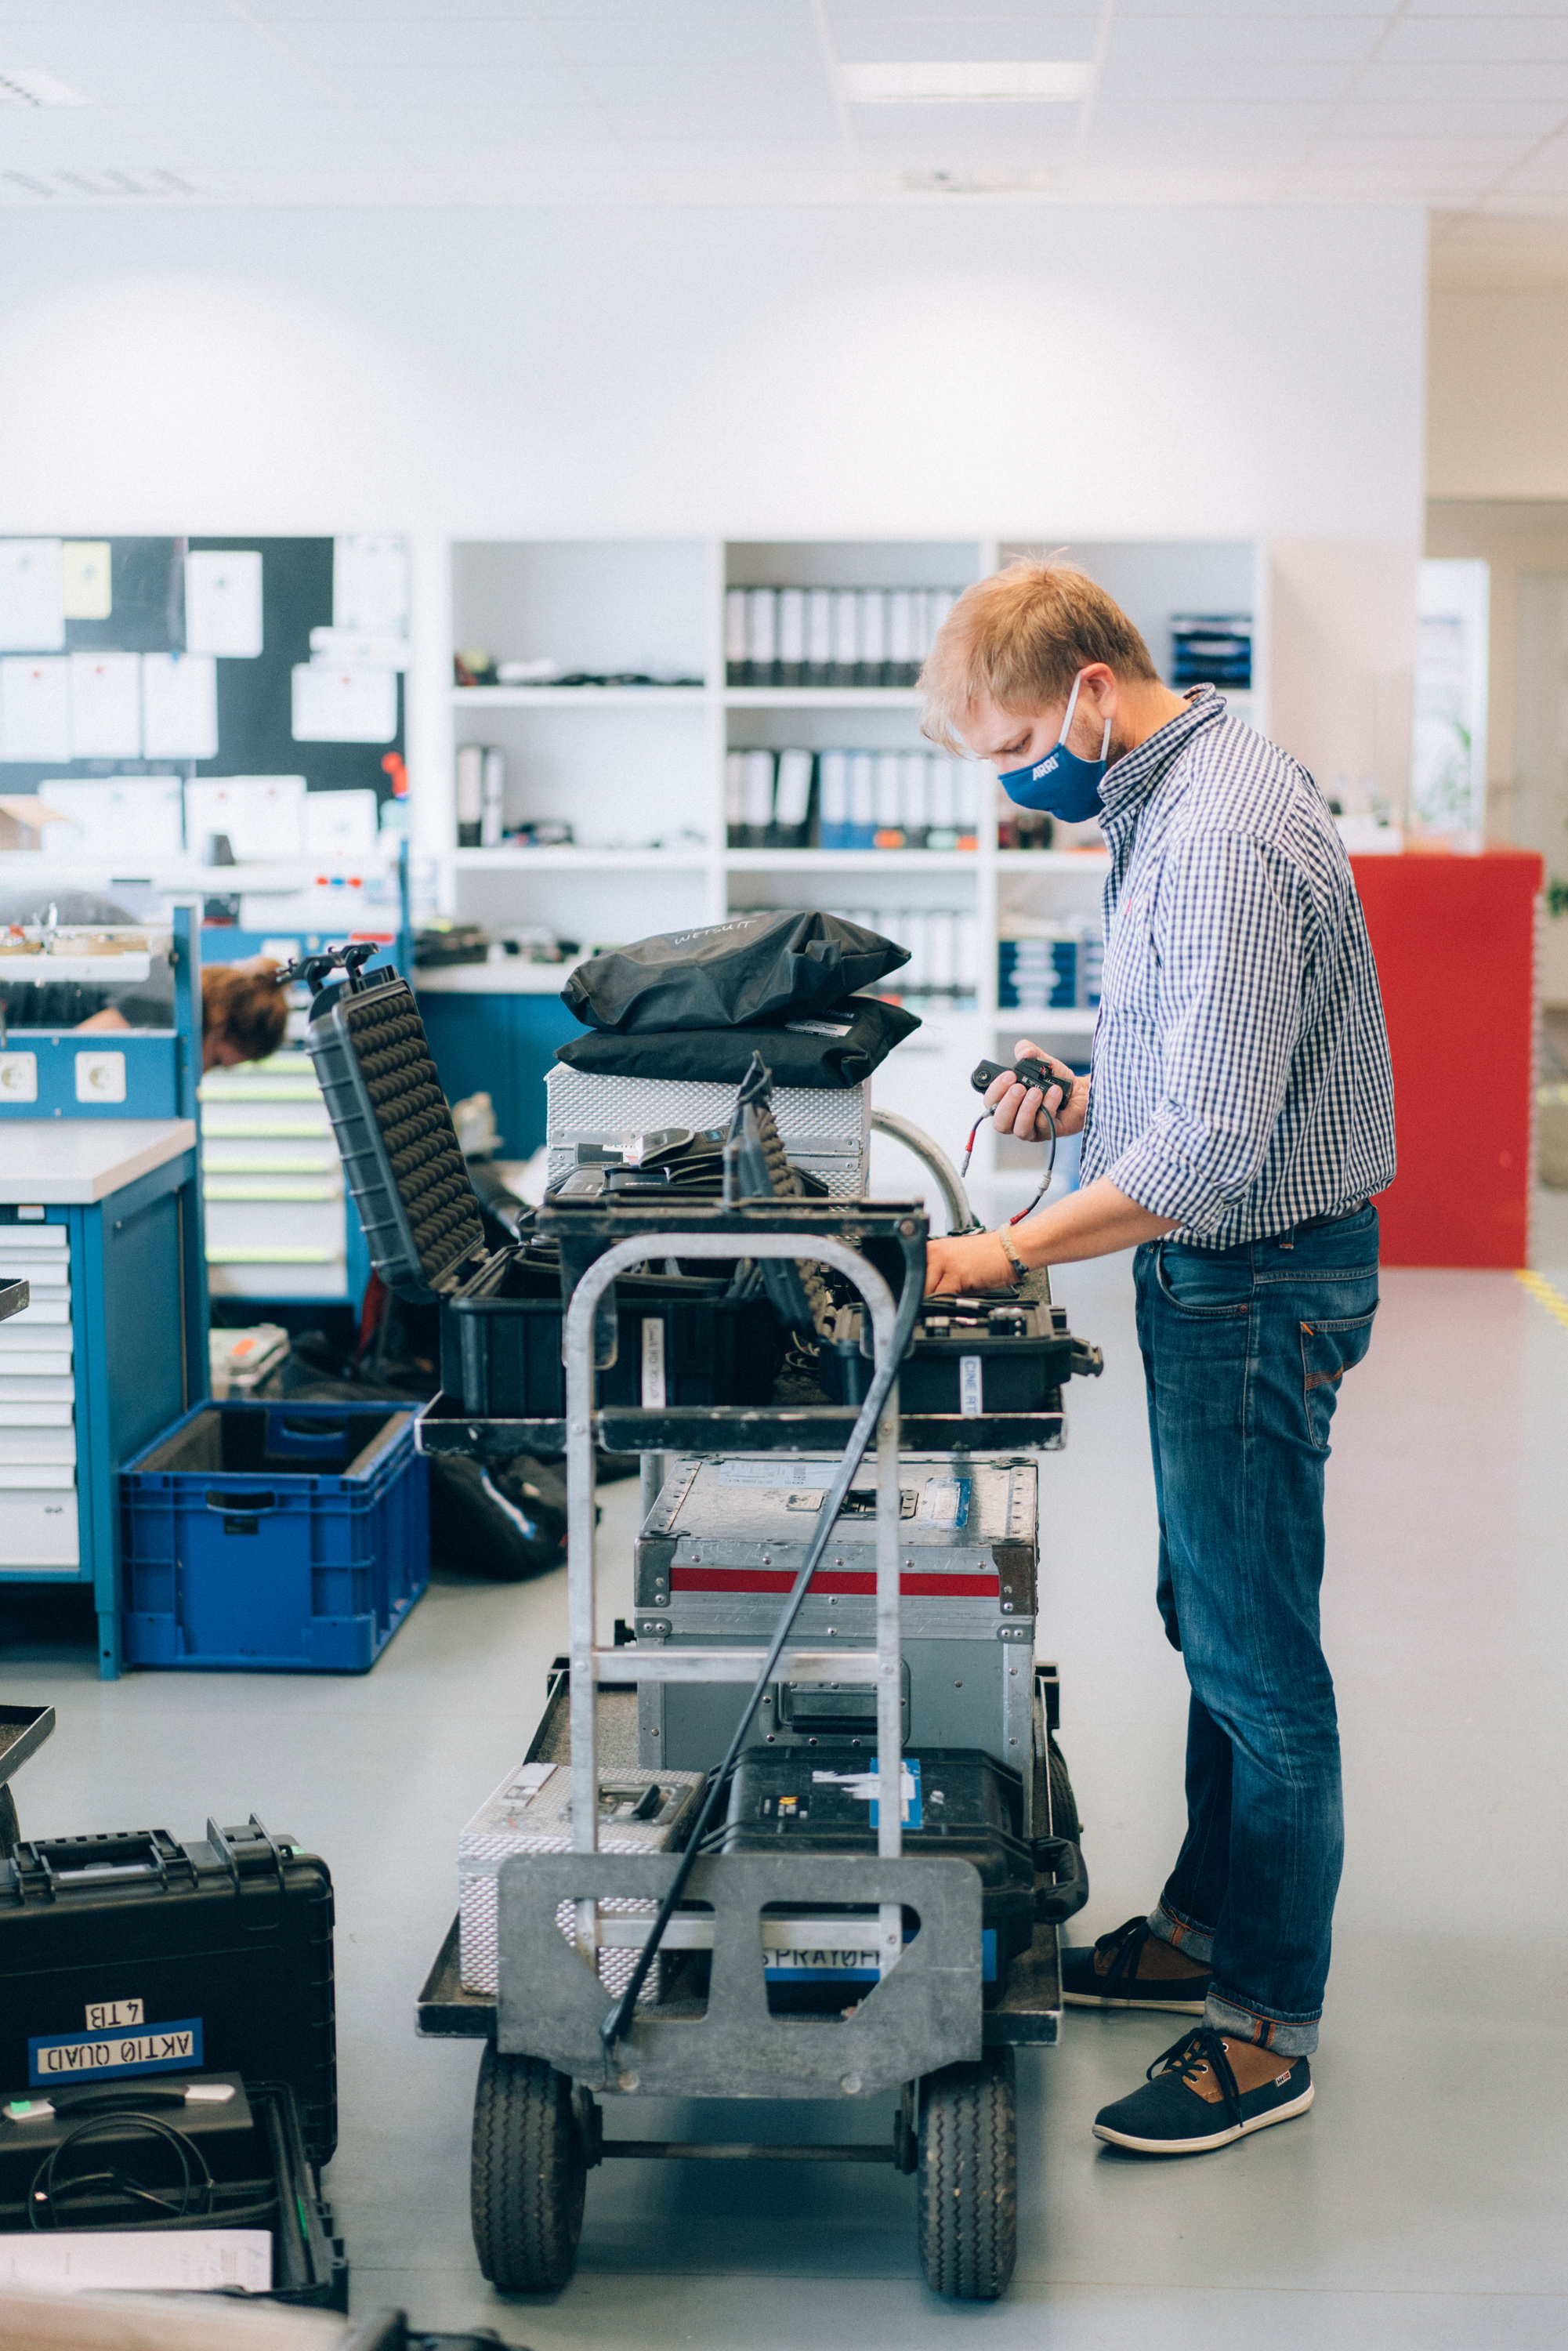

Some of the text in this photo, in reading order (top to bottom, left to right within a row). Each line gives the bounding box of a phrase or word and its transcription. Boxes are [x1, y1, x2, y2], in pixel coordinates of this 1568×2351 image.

[1033, 755, 1059, 781] ARRI
[675, 920, 757, 944] WETSUIT
[964, 1360, 978, 1393] CINE
[91, 2001, 139, 2028] 4 TB
[47, 2044, 110, 2071] QUAD
